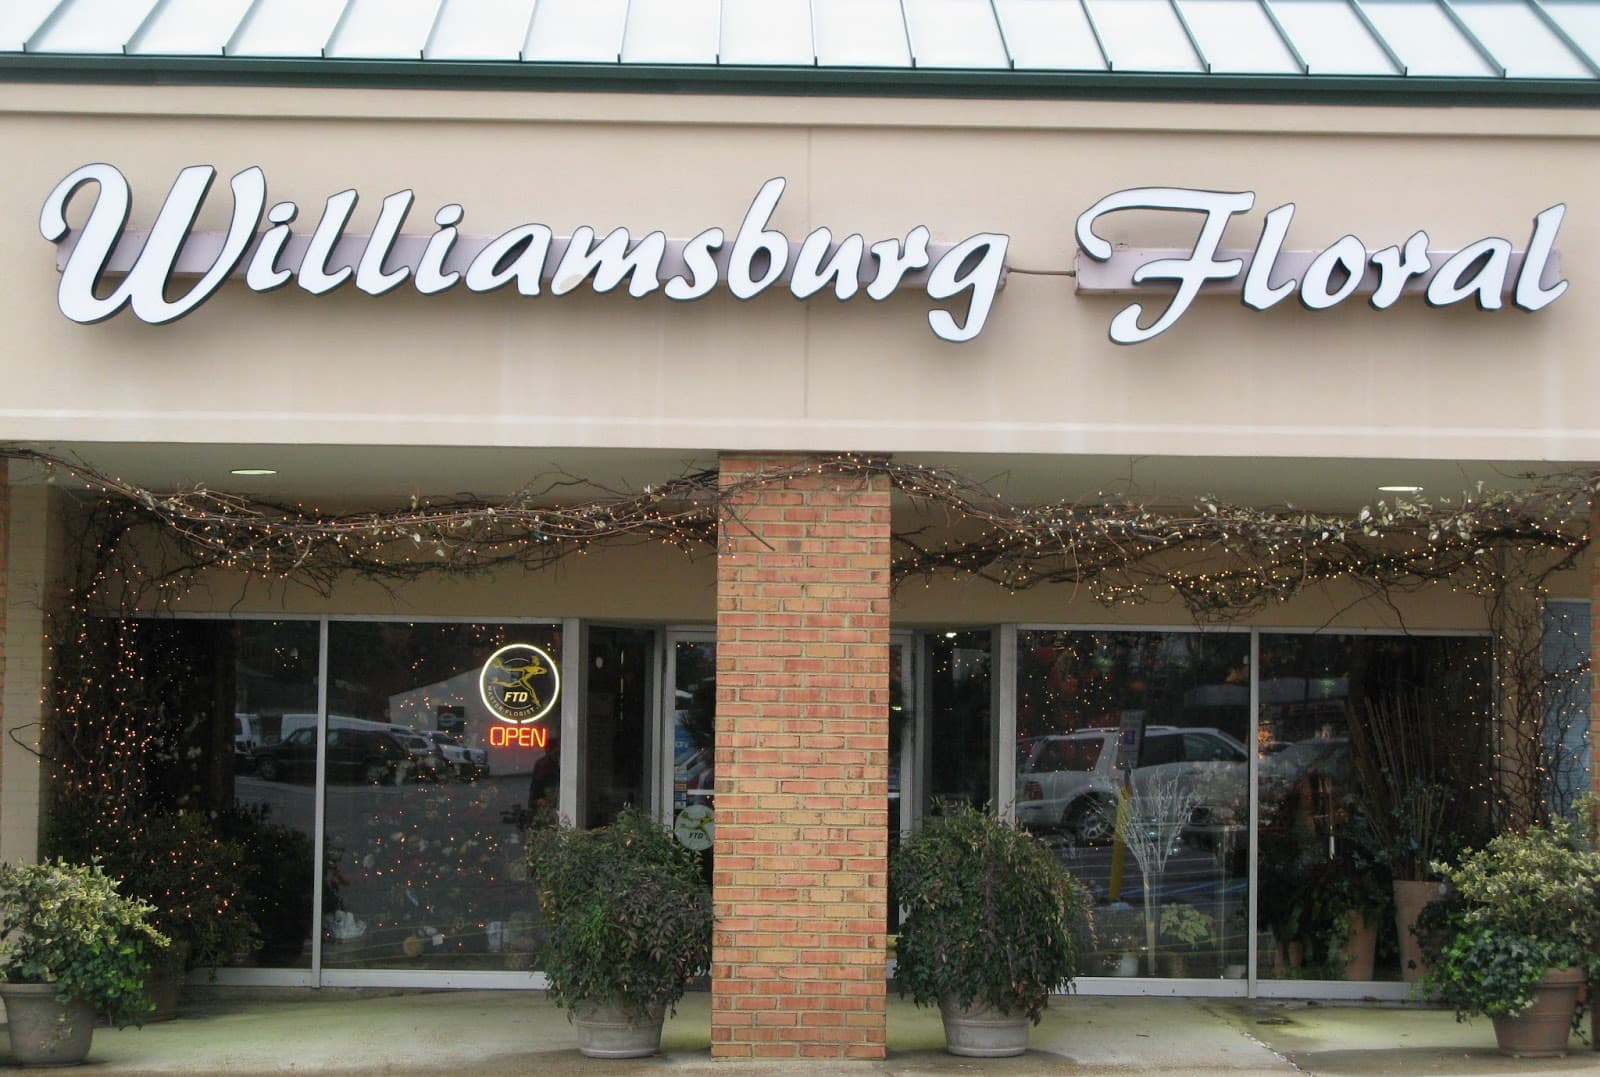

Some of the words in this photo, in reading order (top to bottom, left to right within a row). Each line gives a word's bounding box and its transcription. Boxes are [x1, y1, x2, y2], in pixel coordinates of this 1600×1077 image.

[39, 162, 1009, 342] Williamsburg
[1075, 186, 1569, 345] Floral
[504, 691, 528, 702] FTD
[490, 726, 546, 747] OPEN
